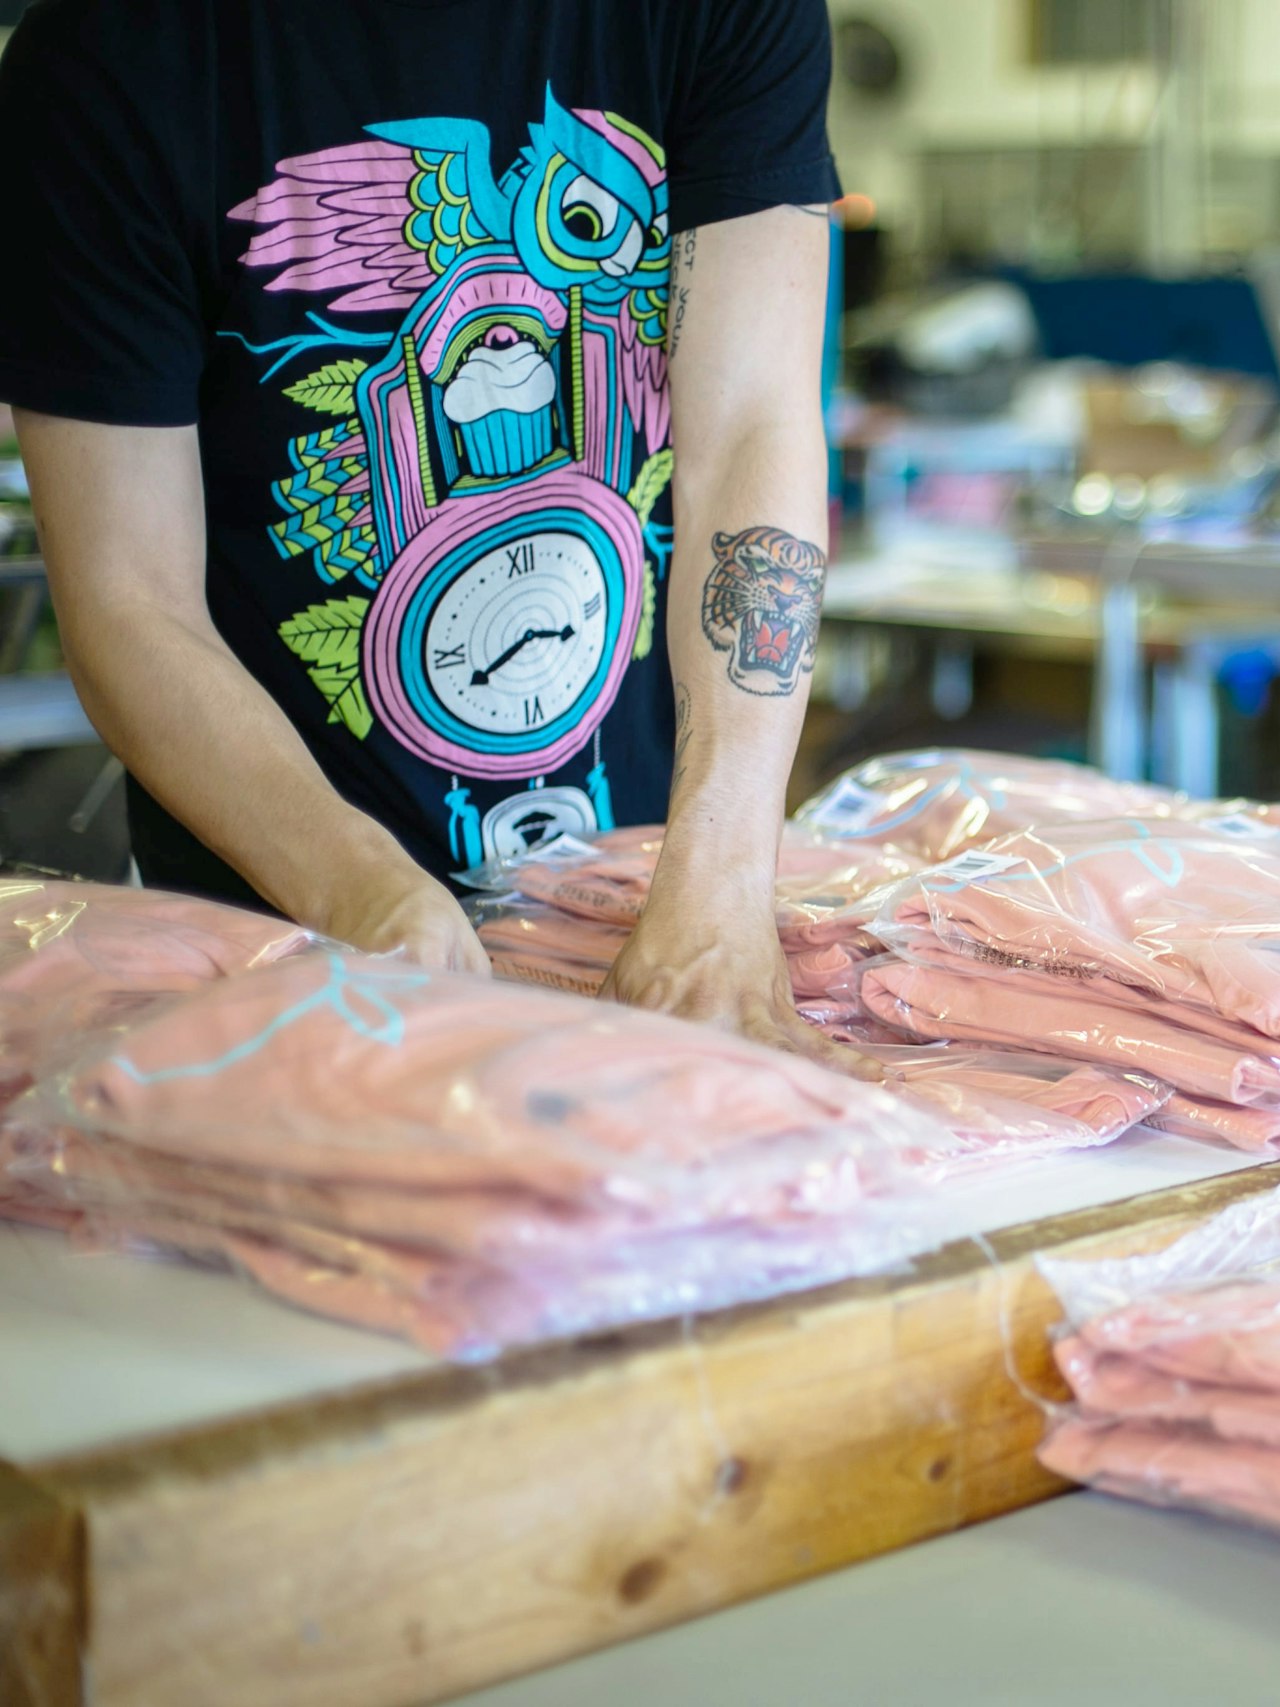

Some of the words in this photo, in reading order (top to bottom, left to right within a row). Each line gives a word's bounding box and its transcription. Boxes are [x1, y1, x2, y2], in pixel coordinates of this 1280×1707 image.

[669, 287, 691, 360] YOUR
[506, 542, 535, 579] XII
[433, 643, 466, 670] IX
[524, 695, 544, 726] VI
